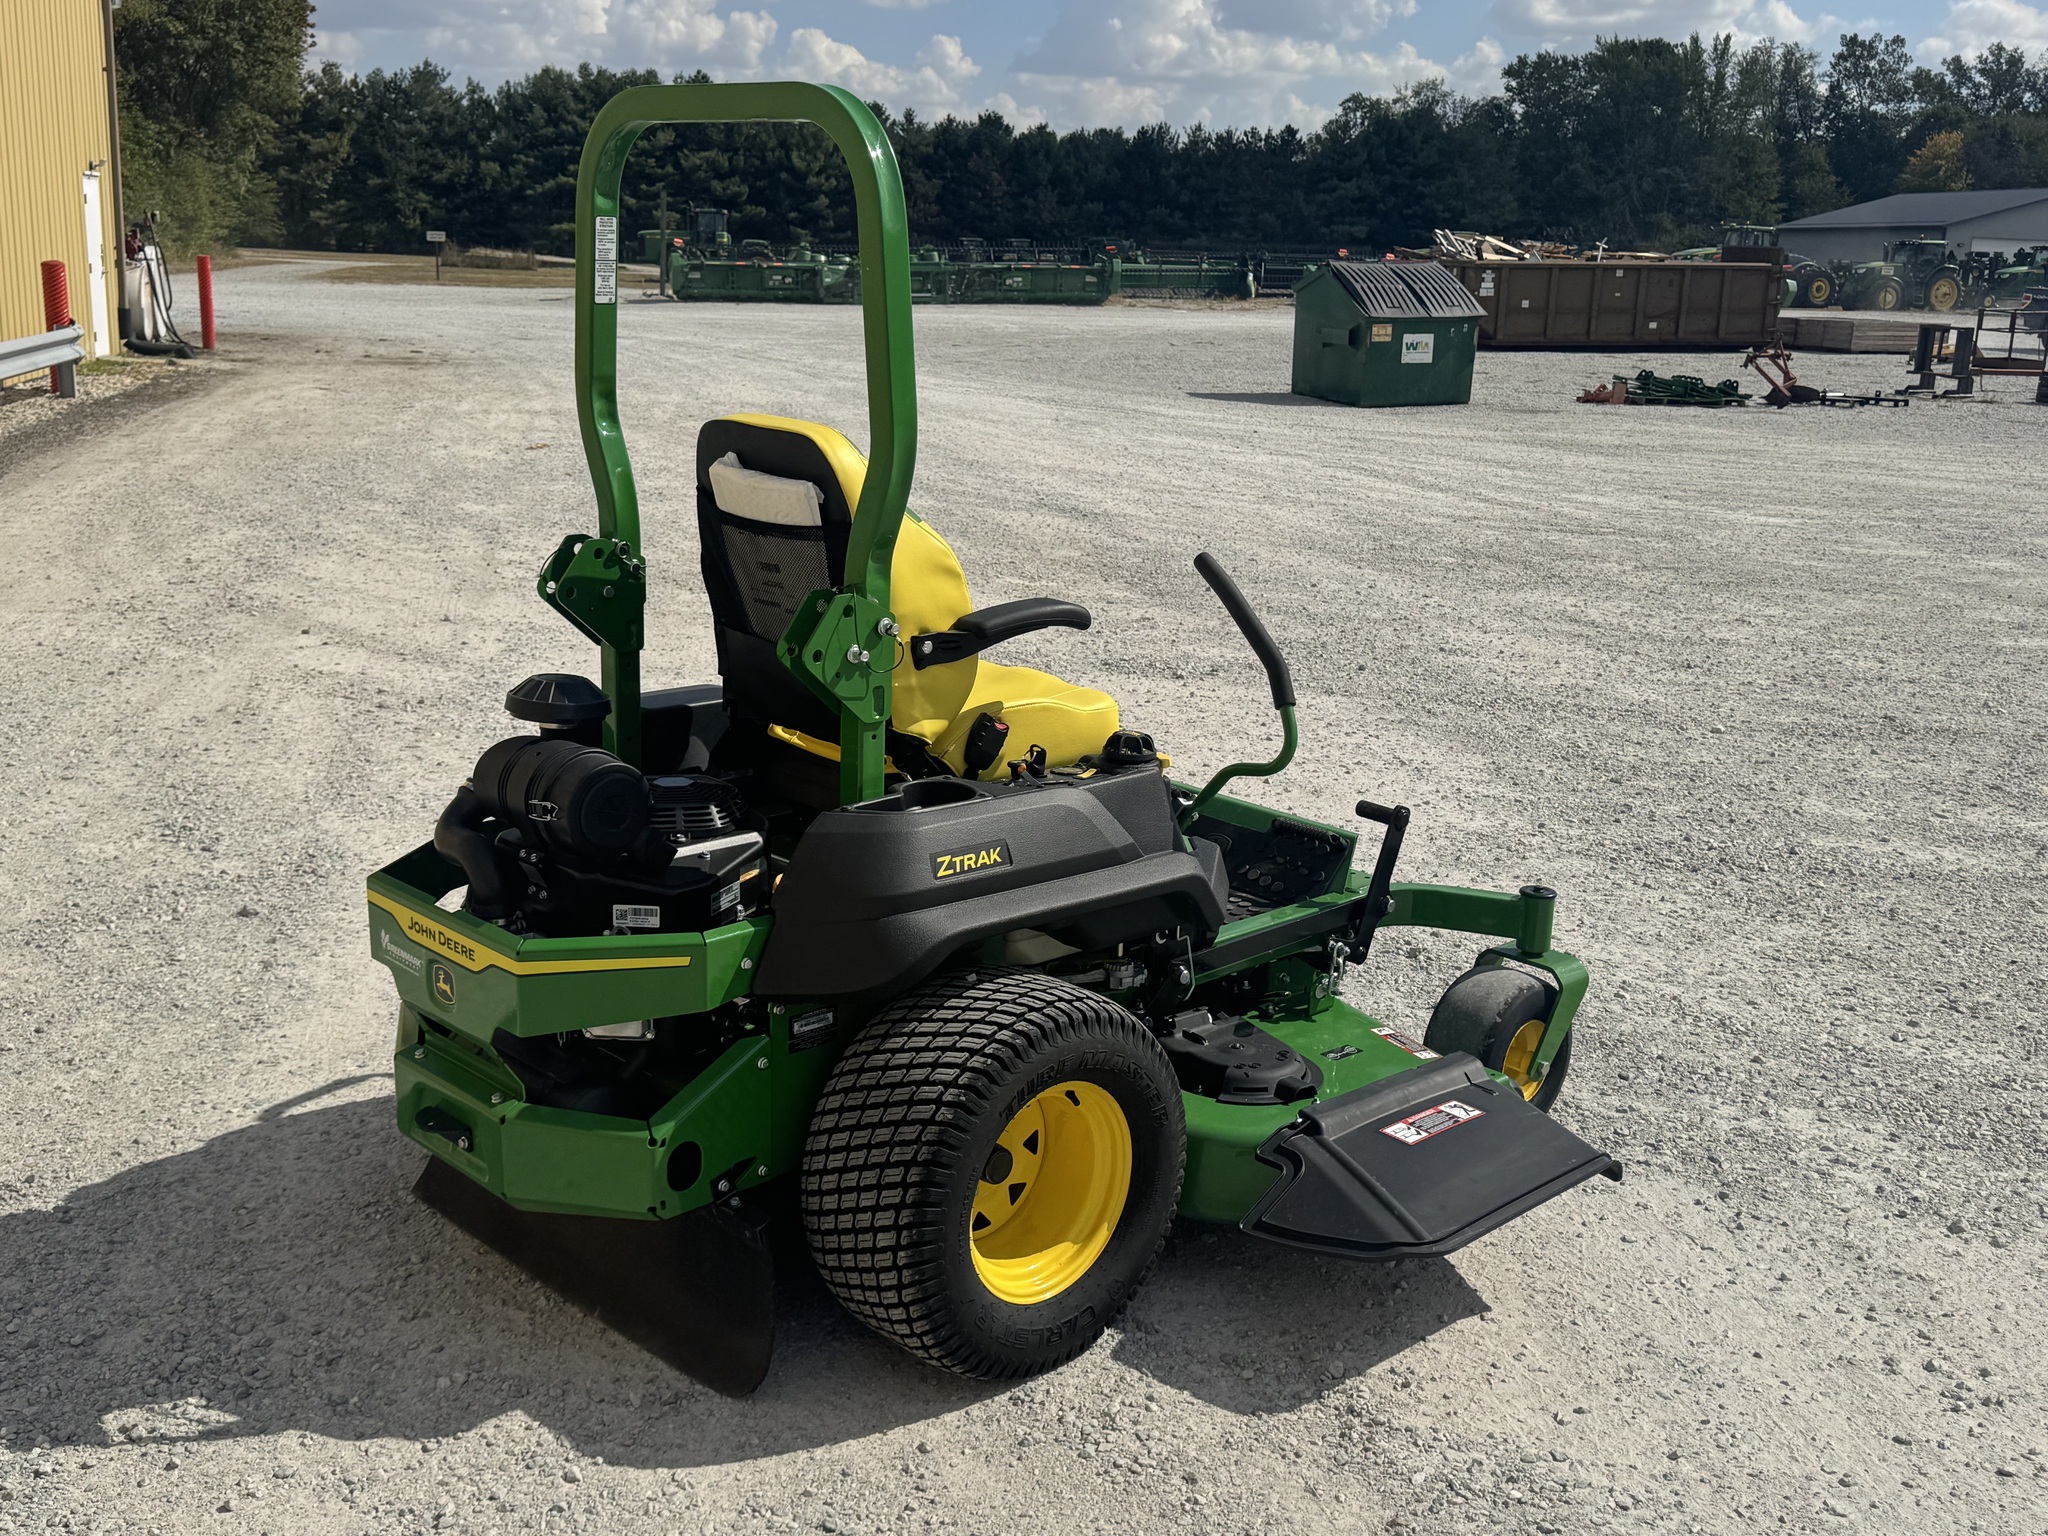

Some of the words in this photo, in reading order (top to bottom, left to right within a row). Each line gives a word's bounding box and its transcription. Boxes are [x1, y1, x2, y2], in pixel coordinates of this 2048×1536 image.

[936, 846, 1003, 878] ZTRAK
[408, 917, 436, 942] JOHN
[438, 930, 476, 962] DEERE
[998, 1053, 1075, 1121] TURF
[1078, 1049, 1169, 1128] MASTER
[973, 1303, 1097, 1350] CARLSTAR
